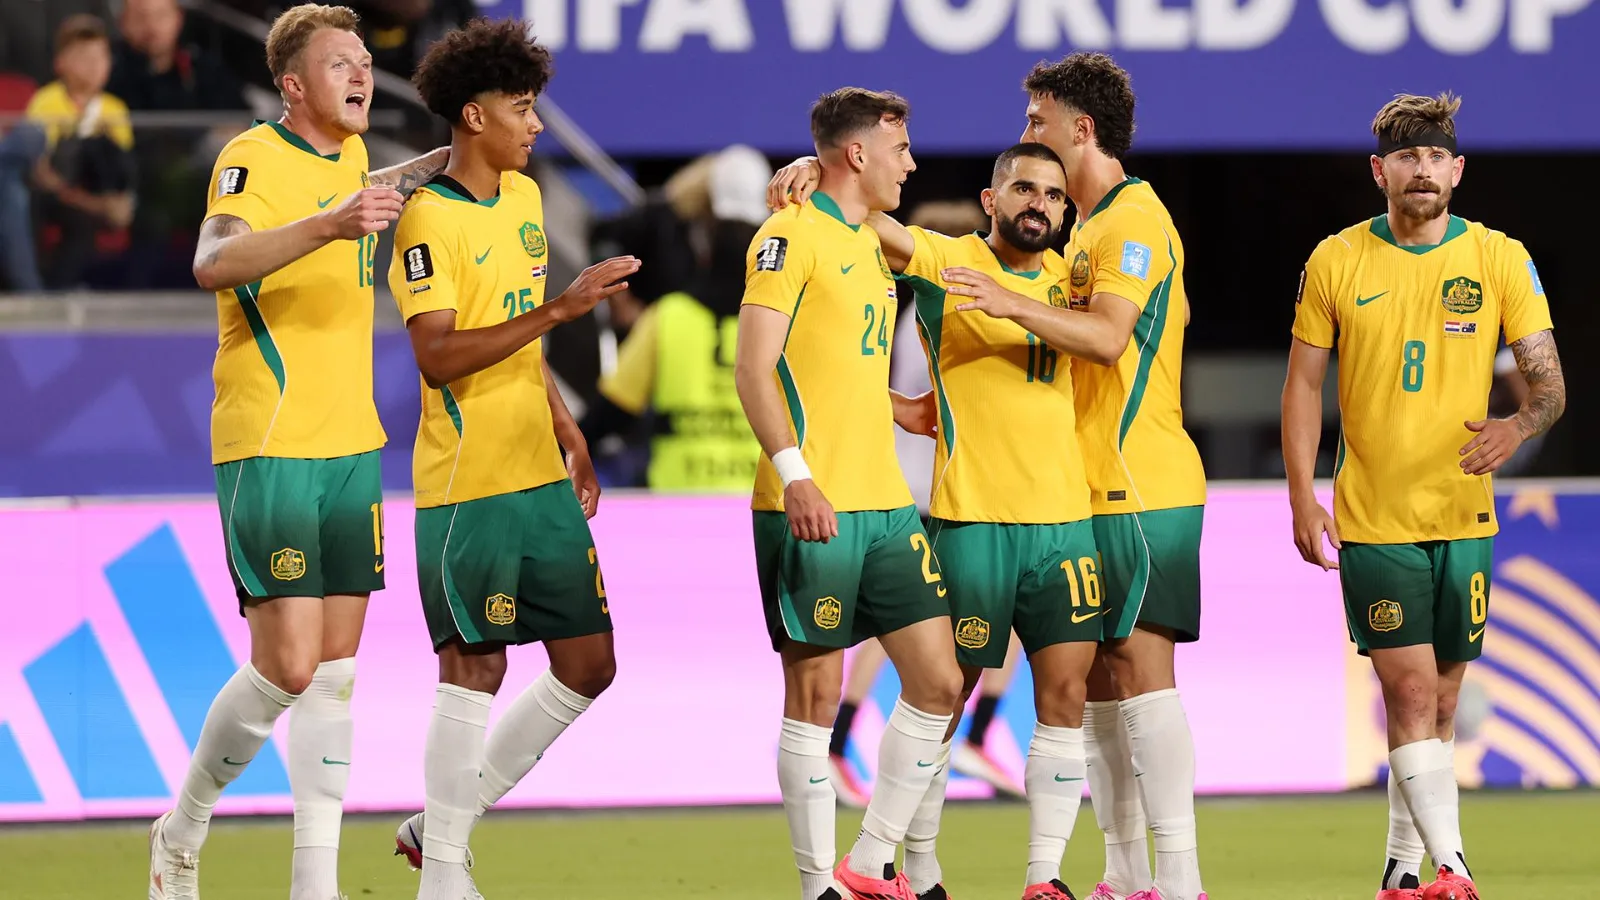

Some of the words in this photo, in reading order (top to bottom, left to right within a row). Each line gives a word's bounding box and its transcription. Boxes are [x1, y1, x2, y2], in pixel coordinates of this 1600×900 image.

[472, 0, 751, 52] IFA
[1318, 0, 1590, 53] CUP
[357, 234, 375, 288] 19
[861, 303, 888, 356] 24
[1025, 332, 1057, 383] 16
[1402, 340, 1426, 392] 8
[370, 502, 384, 556] 1
[1059, 556, 1101, 608] 16
[1469, 571, 1487, 625] 8
